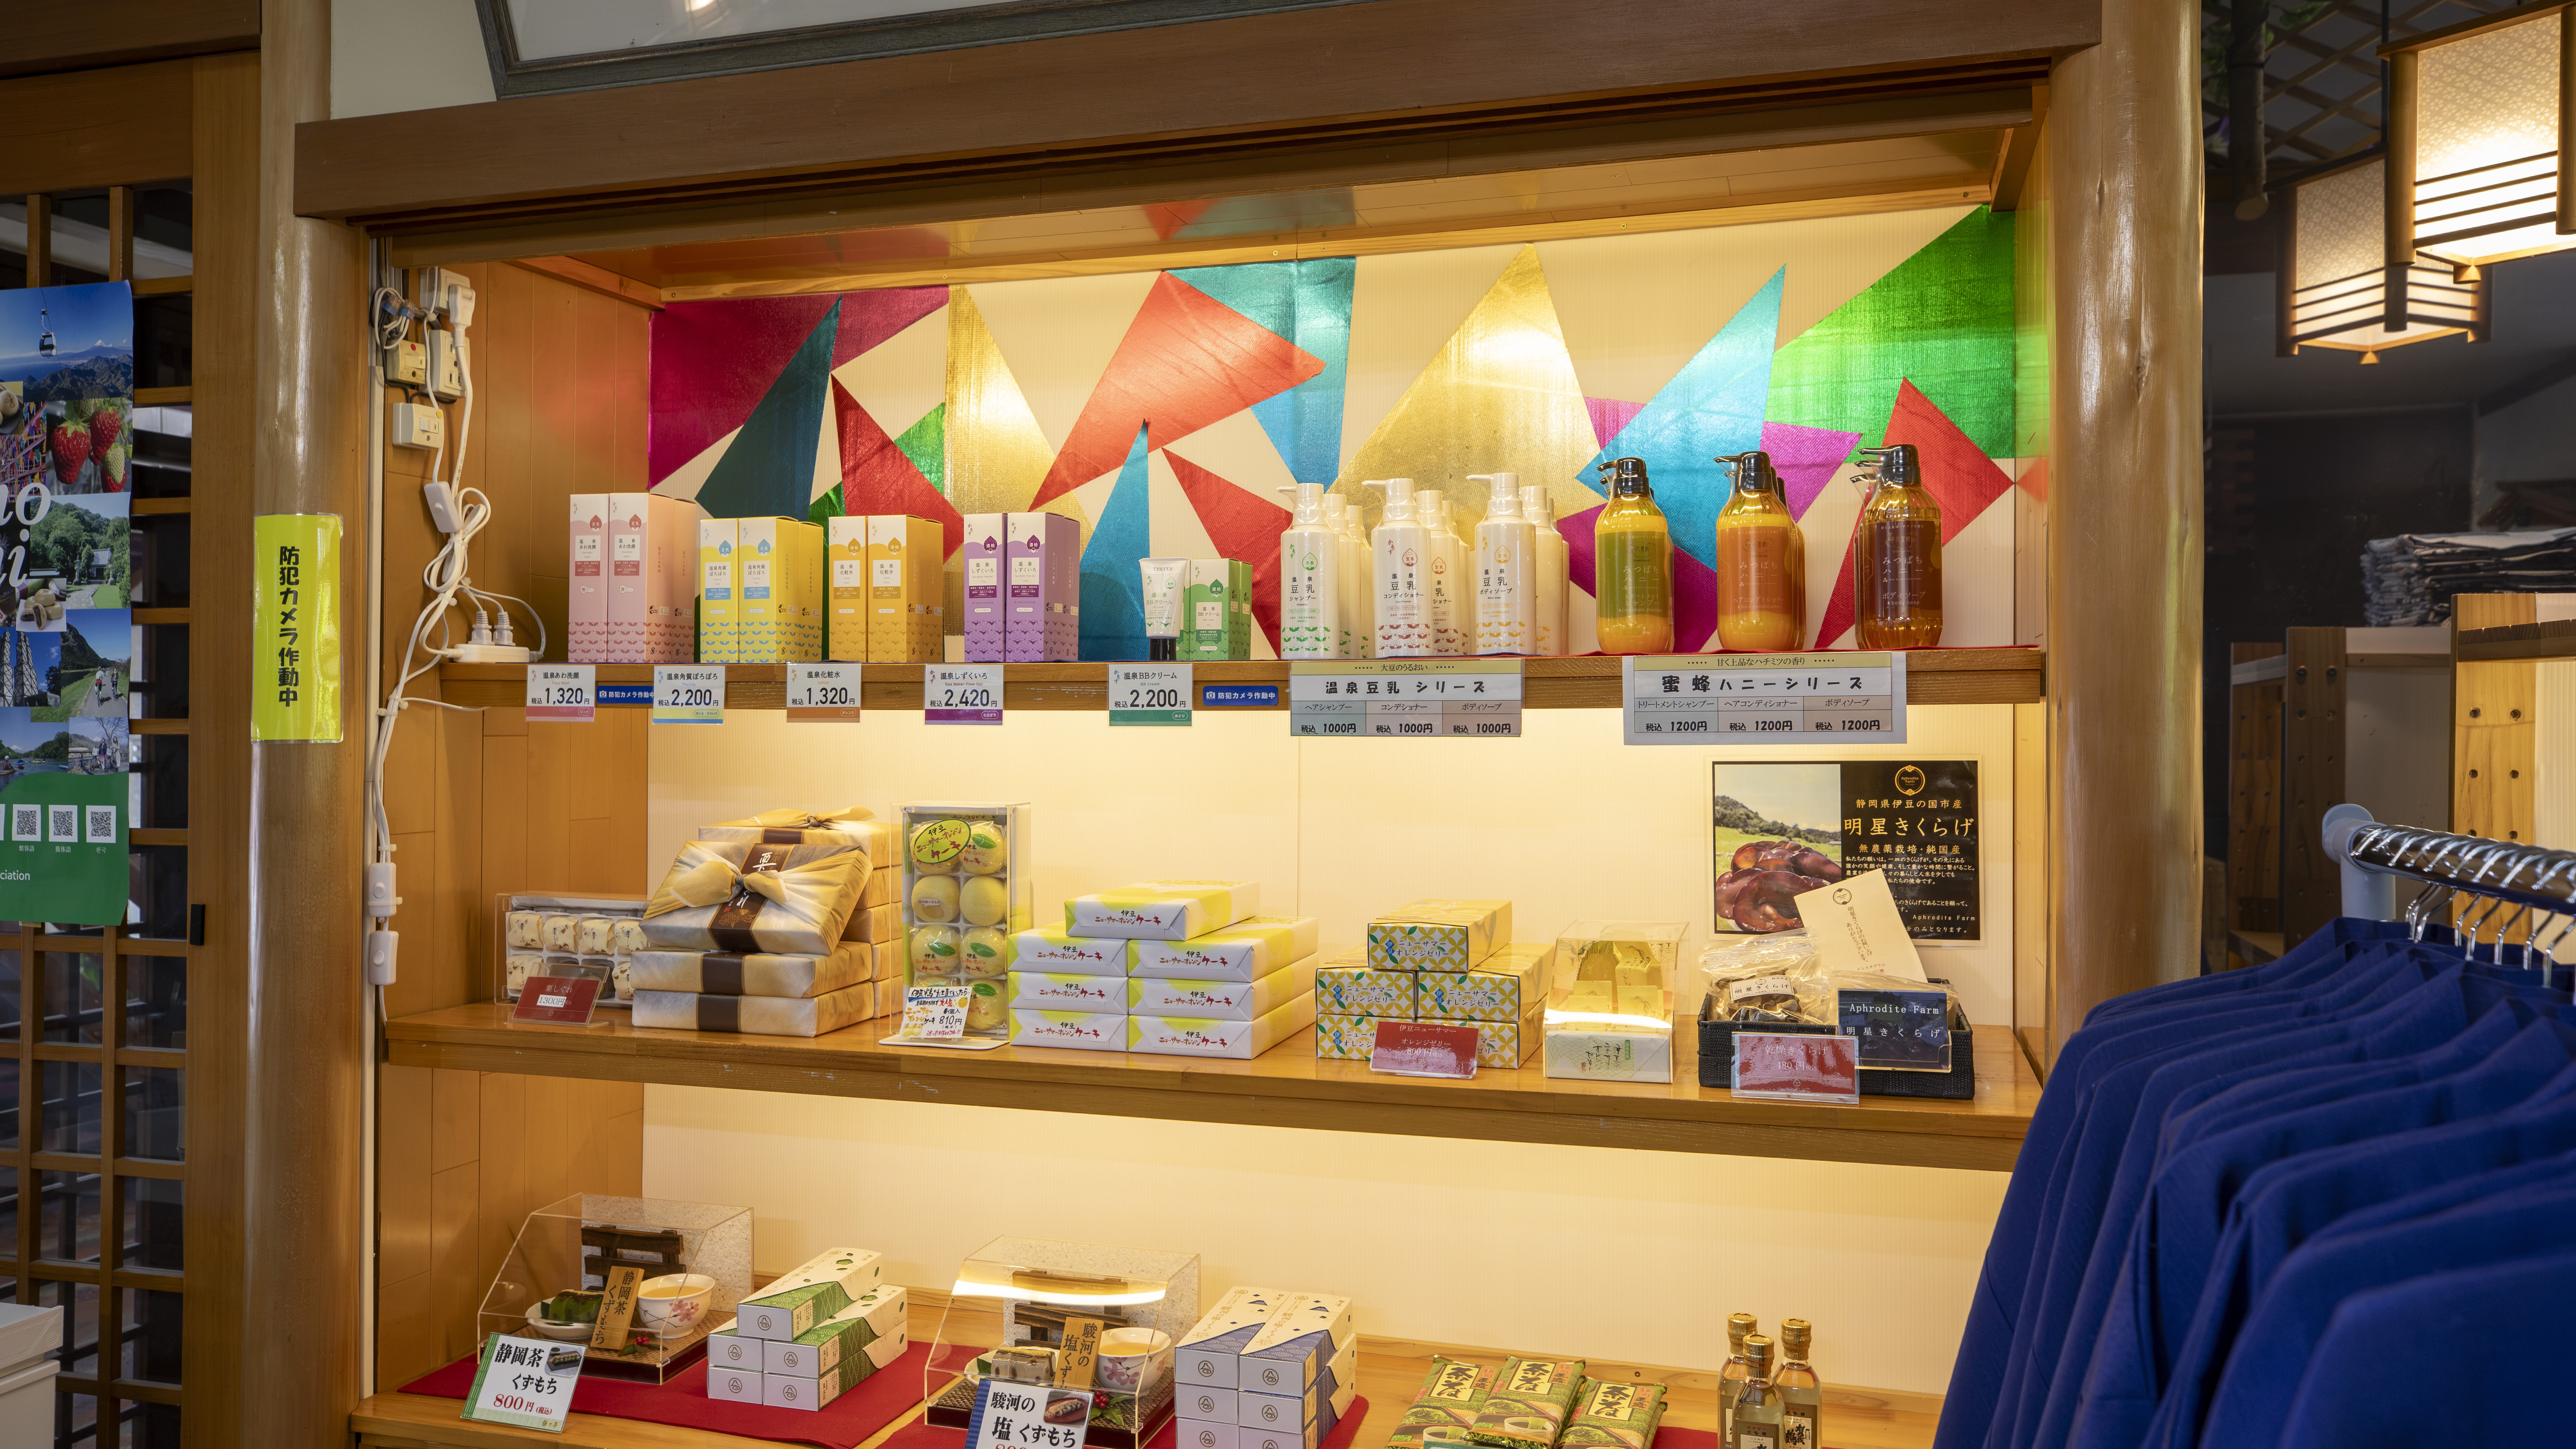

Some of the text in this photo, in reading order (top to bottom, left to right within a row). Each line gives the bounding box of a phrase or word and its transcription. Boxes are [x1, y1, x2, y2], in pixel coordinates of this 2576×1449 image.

[1740, 561, 1777, 570] みつばち
[1883, 556, 1922, 565] みつばち
[1623, 565, 1659, 573] みつばち
[1882, 591, 1926, 600] ボディソープ
[278, 546, 300, 707] 防犯カメラ作動中
[1717, 657, 1805, 666] 甘く上品なハチミツの香り
[1326, 681, 1485, 694] 温泉豆乳 シリーズ
[1662, 675, 1862, 693] 蜜蜂ハニーシリーズ
[545, 687, 590, 705] 1,320円
[671, 689, 719, 707] 2,200円
[944, 689, 997, 708] 2,420円
[1218, 692, 1275, 700] 防犯カメラ作動中
[1638, 700, 1715, 709] トリートメントシャンプー
[1724, 699, 1797, 708] ヘアコンディショナー
[1825, 698, 1870, 707] ボディソープ
[1323, 723, 1356, 733] 1000円
[1399, 723, 1433, 733] 1000円
[1453, 723, 1511, 733] 税込 1000円
[1646, 721, 1707, 731] 税込 1200円
[1729, 720, 1793, 731] 税込 1200円
[1815, 720, 1880, 730] 税込 1200円
[1856, 799, 1962, 809] 静岡県伊豆の国市産
[928, 825, 946, 836] 伊豆
[1844, 817, 1974, 837] 明星きくらげ
[916, 823, 962, 853] ニューサマーオレンジ
[931, 841, 961, 861] ケーキ
[1859, 843, 1961, 854] 無農薬栽培・純国産
[1848, 906, 1872, 956] 明星きくらげのお買い上げ
[1846, 923, 1869, 962] ありがとうございます。
[1396, 949, 1449, 957] オレンジゼリー
[1857, 963, 1886, 971] インスタグラム
[546, 984, 573, 993] 栗しぐれ
[1735, 984, 1789, 994] 明星きくらげ
[539, 996, 565, 1005] 1300円
[939, 998, 953, 1007] 大人気
[1344, 994, 1396, 1003] オレンジゼリー
[1446, 998, 1500, 1007] オレンジゼリー
[905, 1007, 933, 1015] ニューサマー
[1850, 1003, 1940, 1015] Aphrodite Farm
[939, 1015, 962, 1025] 810円
[1399, 1024, 1457, 1033] 伊豆ニューサマー
[1847, 1026, 1940, 1038] 明星きくらげ
[1344, 1039, 1372, 1048] オレンジ
[1401, 1038, 1451, 1047] オレンジゼリー
[1423, 1048, 1433, 1057] 円
[1764, 1044, 1829, 1056] 乾燥きくらげ
[1776, 1061, 1805, 1071] 480 円
[614, 1270, 635, 1316] 静岡茶
[1078, 1322, 1097, 1367] 駿河の
[494, 1343, 545, 1368] 静岡茶
[1436, 1367, 1474, 1398] 茶そば
[1514, 1363, 1550, 1392] 茶そば
[512, 1373, 557, 1395] くずもち
[991, 1391, 1035, 1413] 駿河の
[1594, 1385, 1631, 1417] 茶そば
[536, 1406, 552, 1415] (税込)
[992, 1416, 1076, 1448] 塩 くずもち
